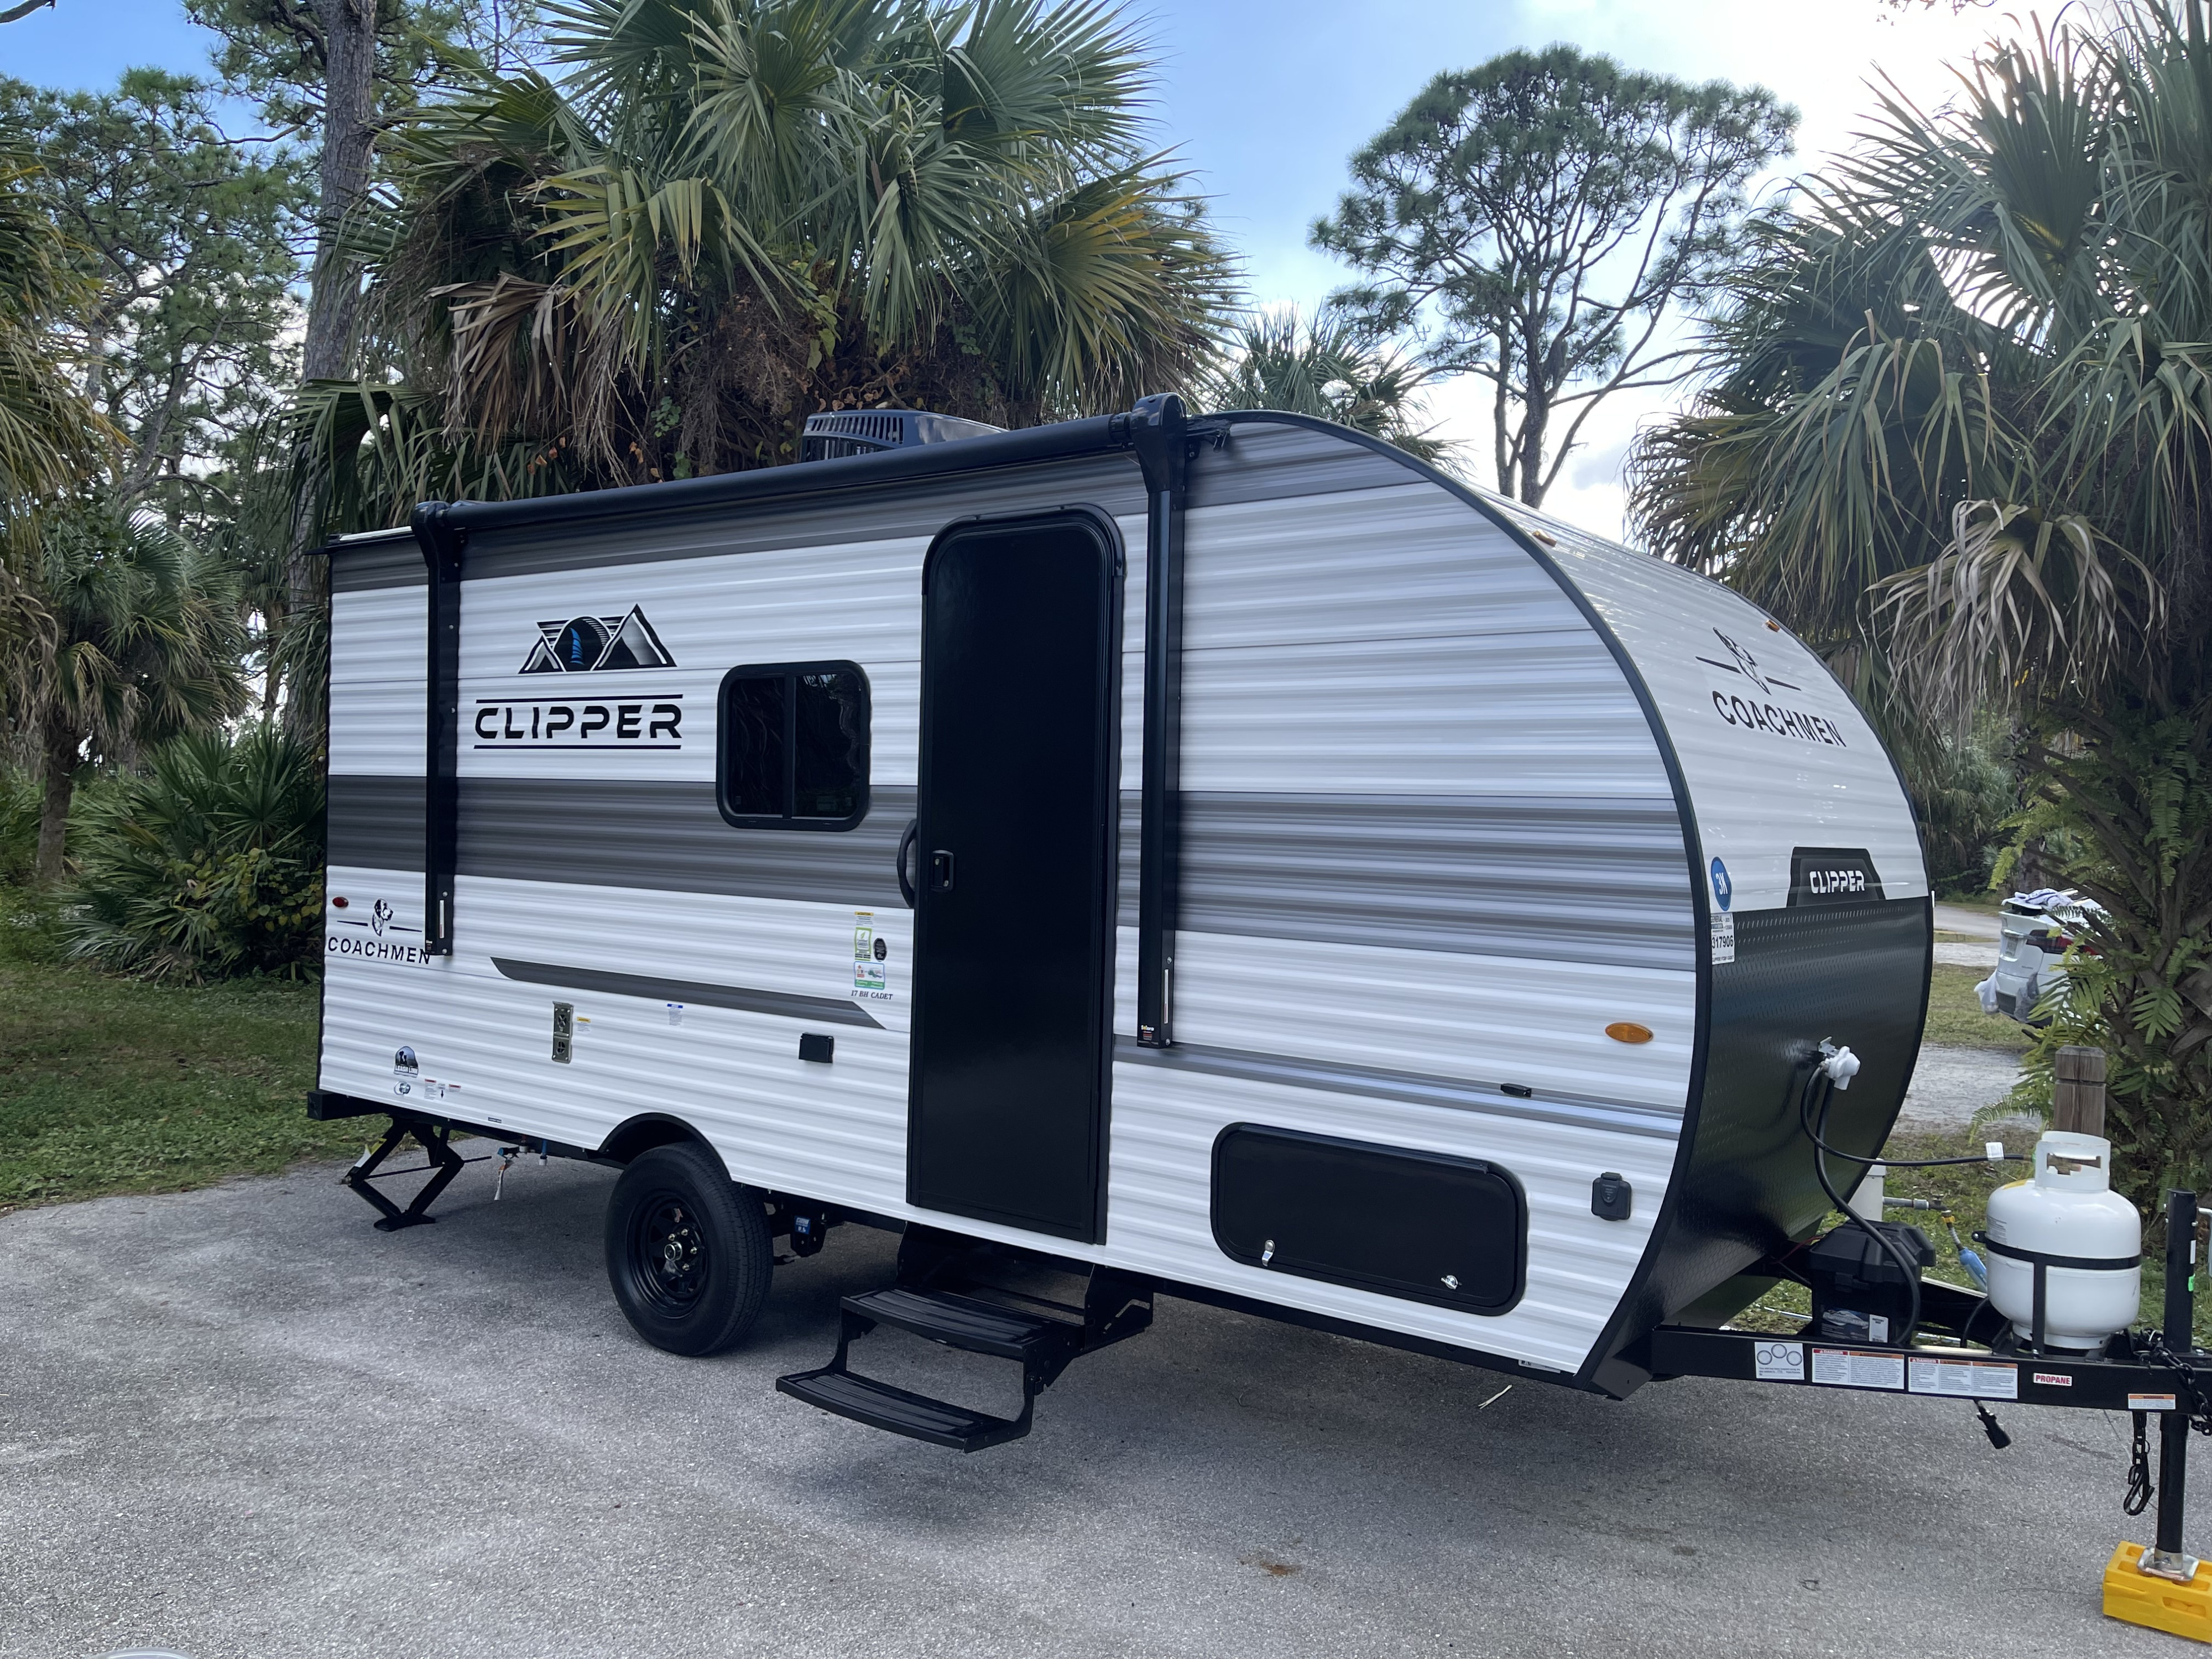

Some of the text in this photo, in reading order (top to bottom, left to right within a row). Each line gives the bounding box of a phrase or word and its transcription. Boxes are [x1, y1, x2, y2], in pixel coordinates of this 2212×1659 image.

[474, 703, 683, 740] CLIPPER
[1712, 690, 1847, 748] COACHMEN
[1809, 869, 1866, 894] CLIPPER
[328, 937, 430, 964] COACHMEN
[1712, 935, 1734, 949] 317906
[2035, 1375, 2070, 1385] PROPANE
